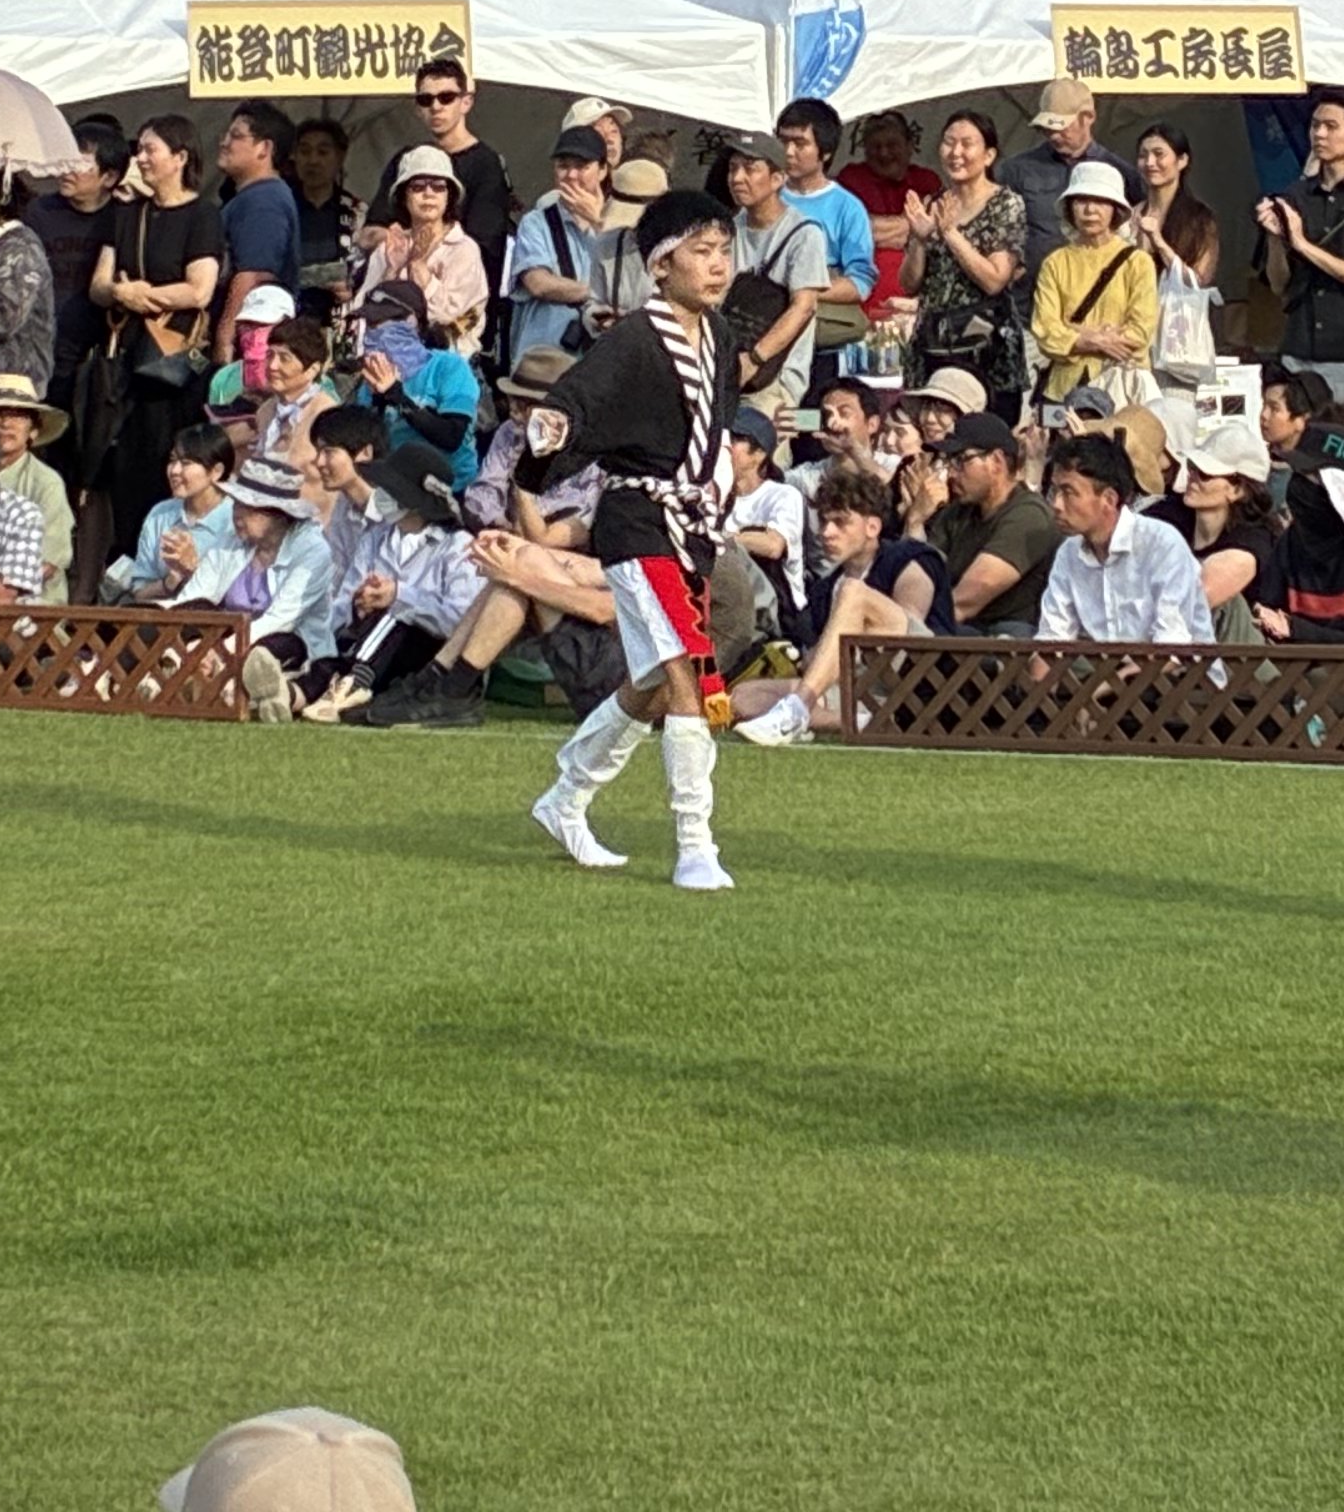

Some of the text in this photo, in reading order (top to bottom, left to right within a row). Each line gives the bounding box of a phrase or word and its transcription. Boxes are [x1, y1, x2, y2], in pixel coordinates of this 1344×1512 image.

[1063, 25, 1297, 80] 輪島工房長屋
